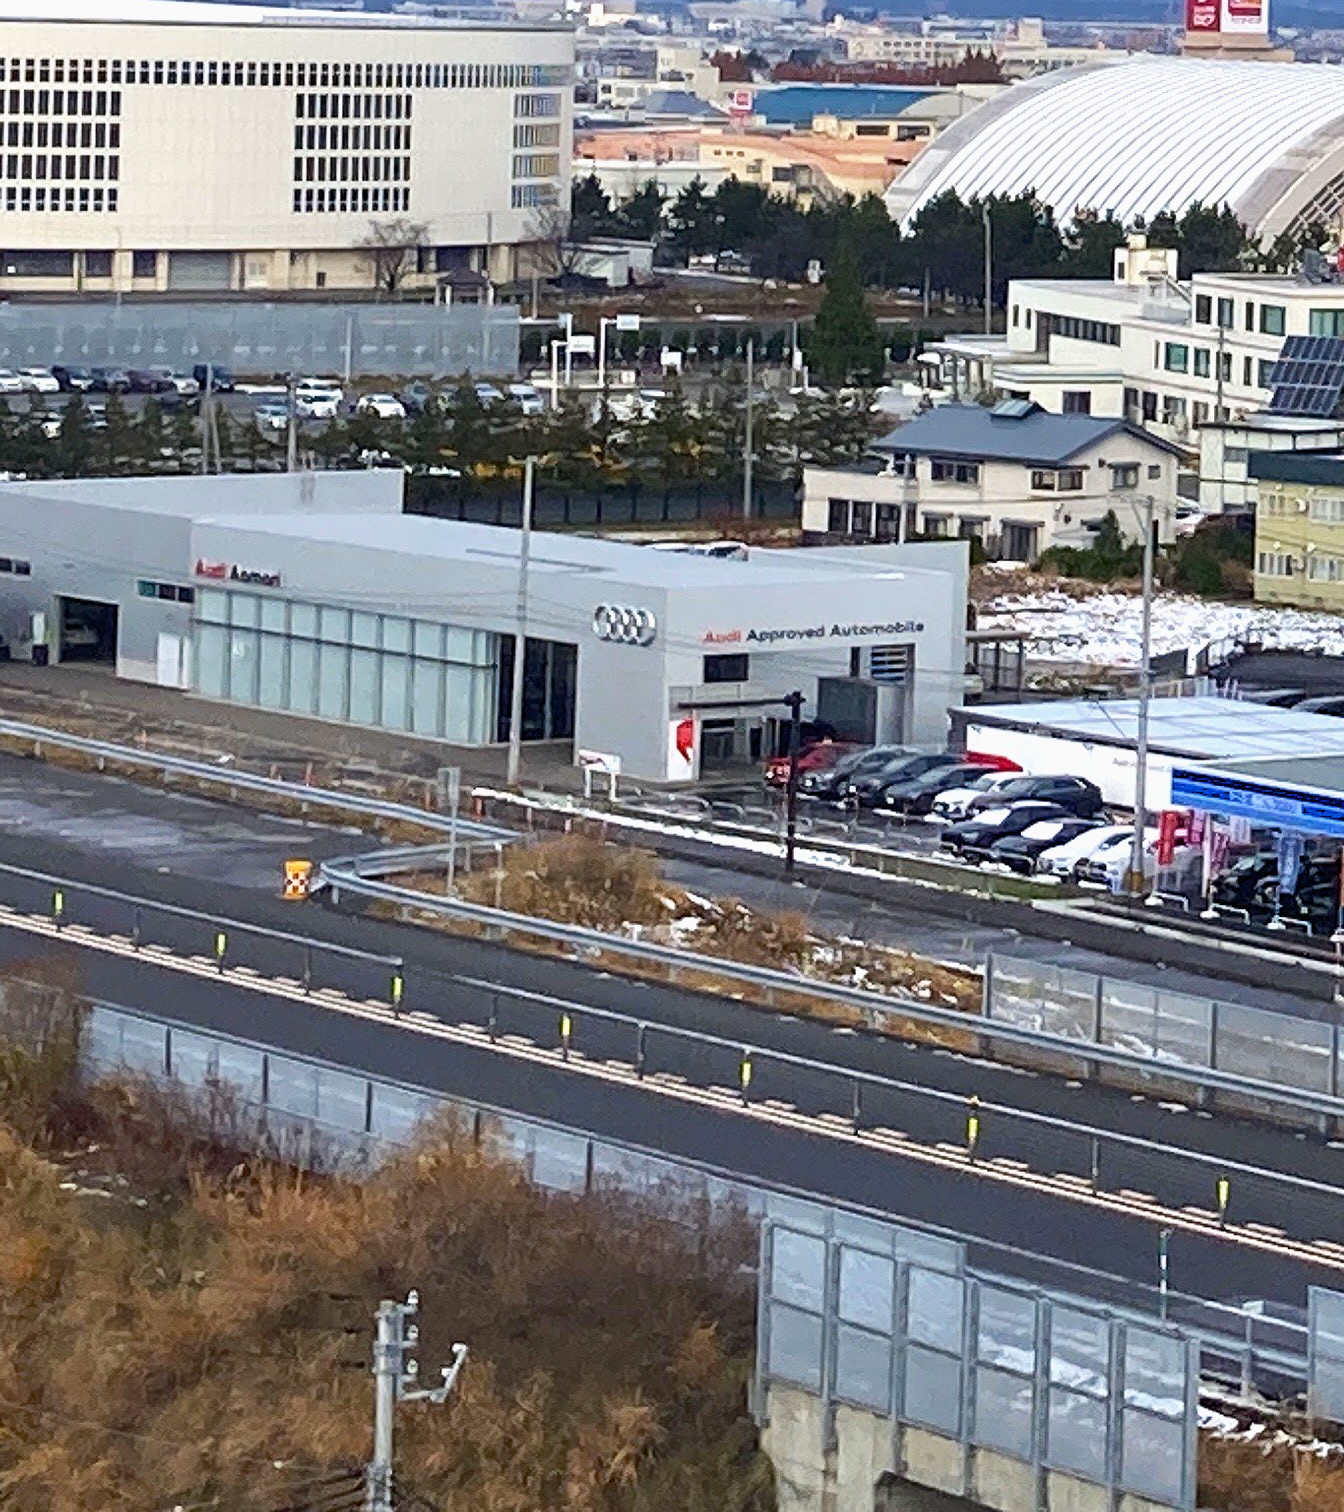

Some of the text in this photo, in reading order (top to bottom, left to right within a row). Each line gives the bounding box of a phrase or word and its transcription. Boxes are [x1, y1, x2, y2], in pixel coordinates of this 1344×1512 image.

[704, 620, 925, 644] Audi Approved Automobile
